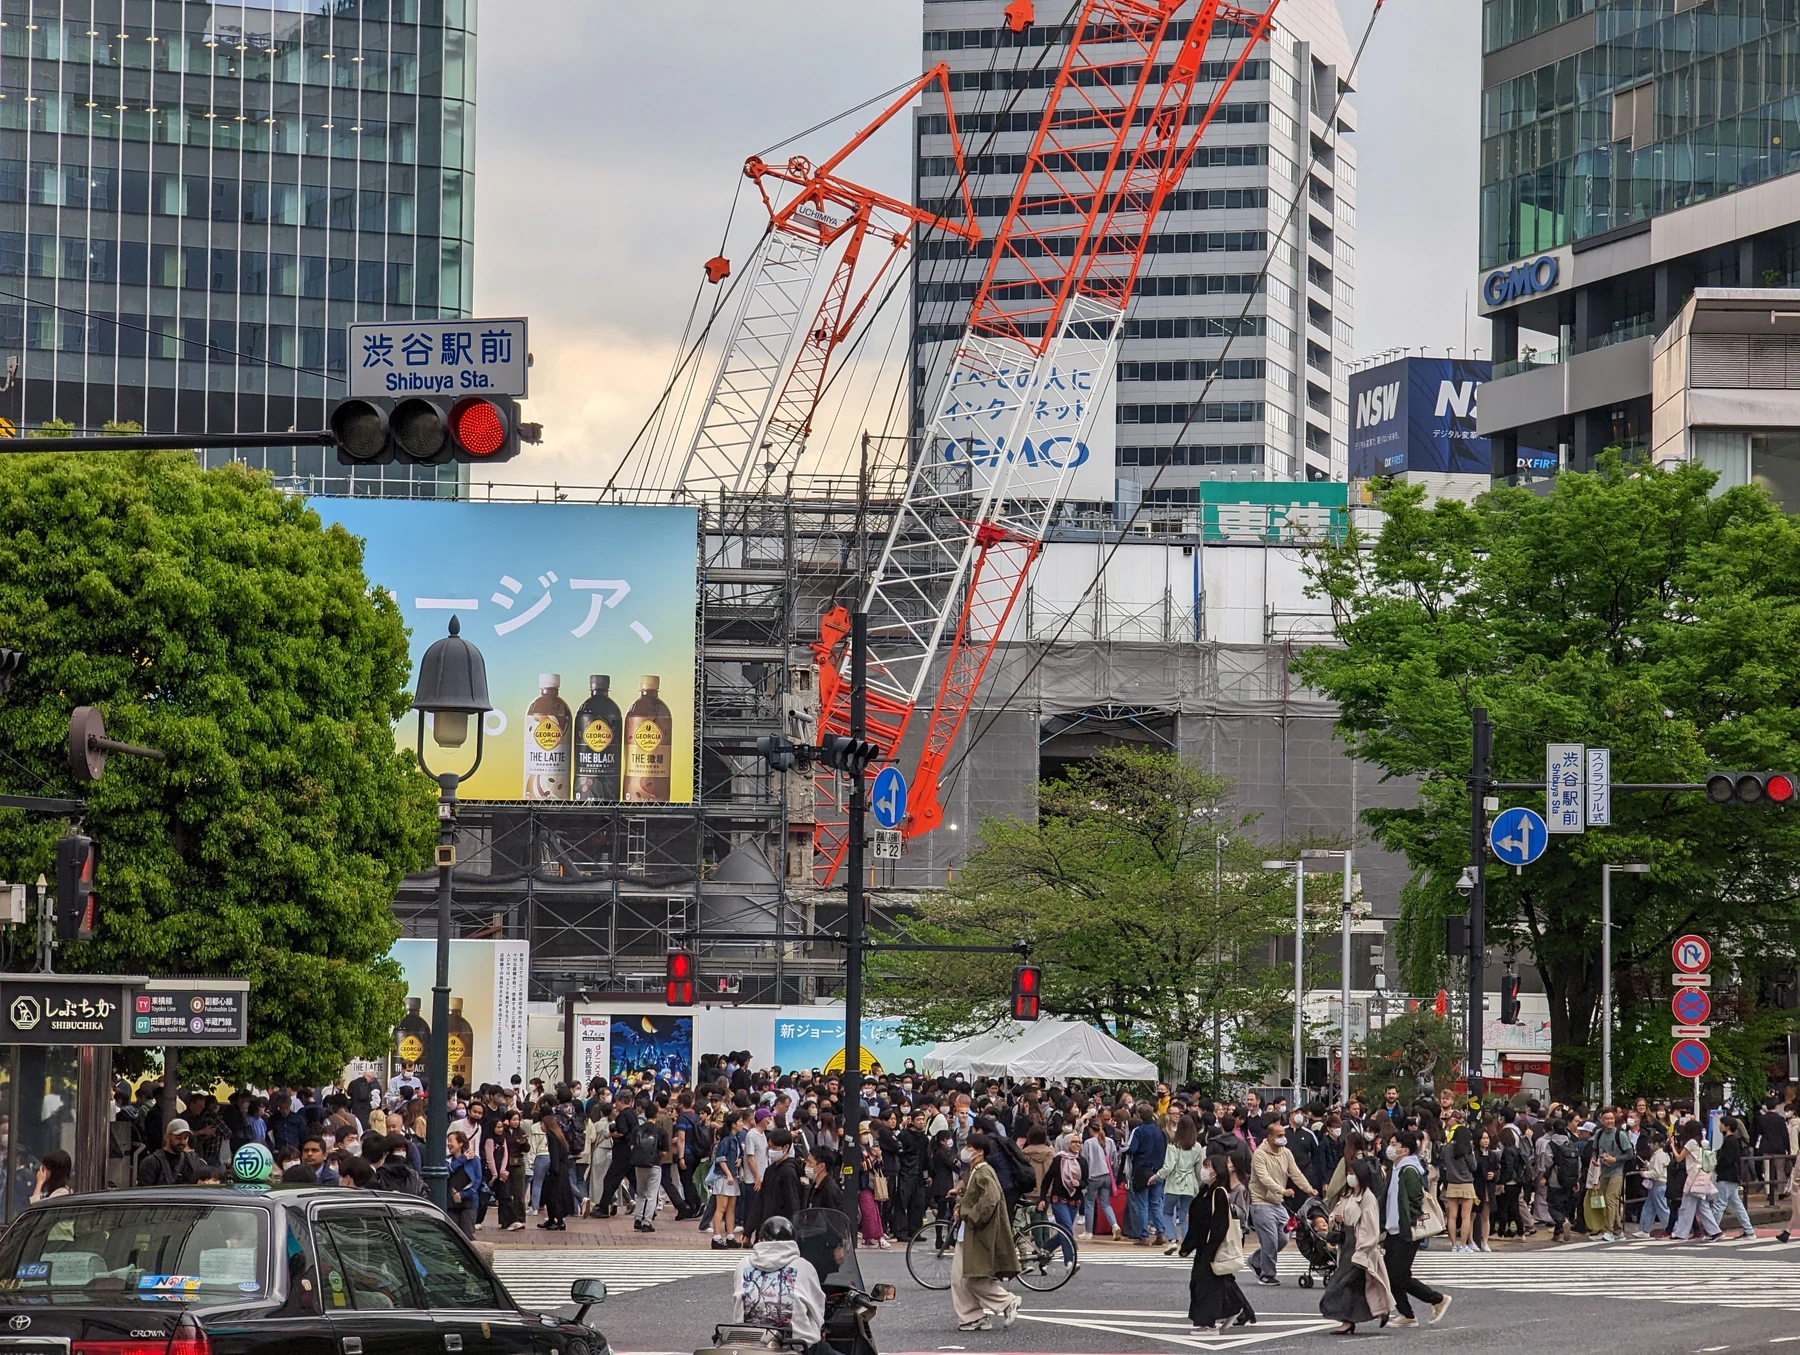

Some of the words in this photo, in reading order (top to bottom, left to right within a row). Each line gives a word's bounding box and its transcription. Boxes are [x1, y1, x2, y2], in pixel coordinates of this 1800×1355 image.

[799, 206, 837, 226] UCHIMIYA
[1484, 256, 1557, 305] GMO
[363, 329, 512, 367] 渋谷駅前
[386, 372, 454, 393] Shibuya
[460, 370, 495, 389] Sta.
[1356, 381, 1400, 430] NSW
[945, 436, 1090, 468] GMO
[530, 752, 543, 762] THE
[544, 752, 565, 762] LATTE
[580, 753, 592, 763] THE
[593, 753, 615, 763] BLACK
[632, 754, 646, 764] THE
[1551, 763, 1561, 797] Shibuya
[1563, 752, 1578, 825] 渋谷駅前
[1592, 753, 1604, 822] スクランブル式
[1552, 800, 1561, 817] Sta.
[45, 998, 116, 1018] しぶちか
[151, 997, 173, 1006] 東横線
[51, 1022, 104, 1030] SHIBUCHIKA
[151, 1018, 186, 1026] 田園都市線
[130, 1329, 165, 1337] CROWN
